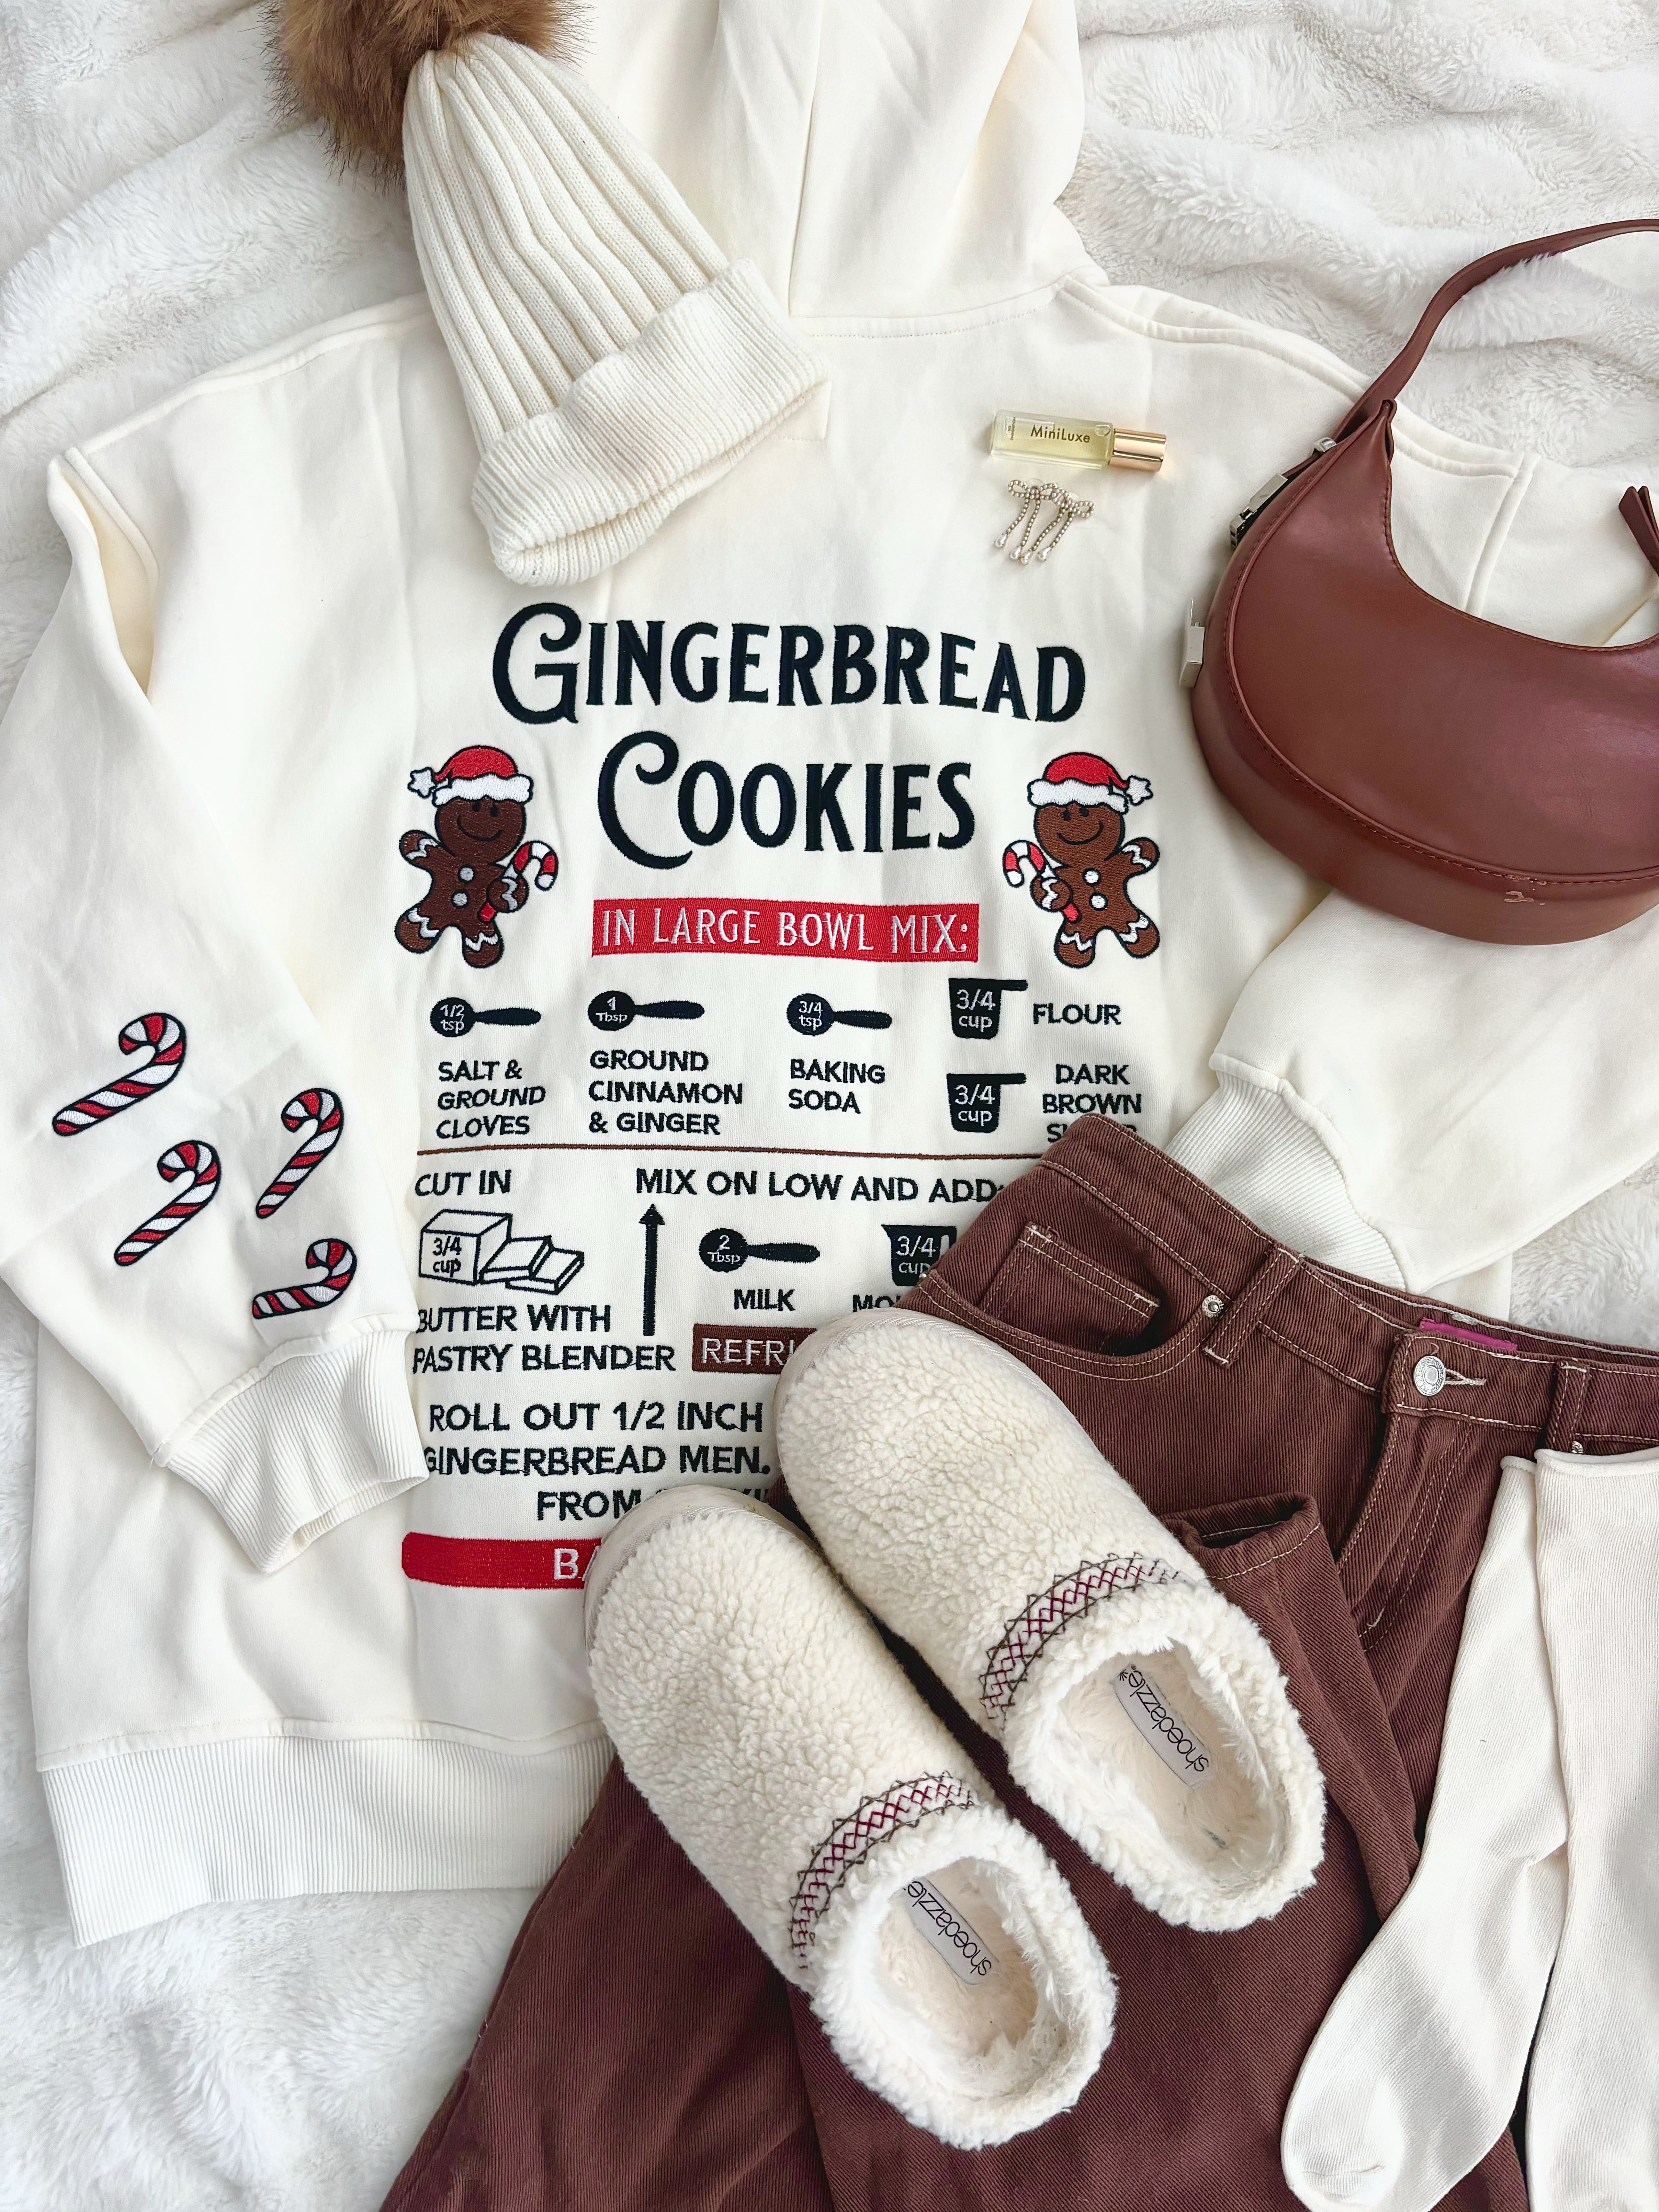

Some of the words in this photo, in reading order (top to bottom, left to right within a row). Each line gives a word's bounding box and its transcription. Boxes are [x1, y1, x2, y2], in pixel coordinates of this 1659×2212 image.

[1031, 425, 1090, 443] MiniLuxe
[493, 603, 1085, 724] GINGERBREAD
[598, 731, 975, 870] COOKIES
[602, 909, 635, 946] IN
[652, 907, 760, 945] LARGE
[778, 912, 873, 950] BOWL
[891, 914, 967, 953] MIX:
[607, 997, 616, 1010] 1
[799, 1001, 821, 1015] 3/4
[957, 989, 996, 1010] 3/4
[440, 1005, 464, 1017] 1/2
[596, 1012, 627, 1023] Tbsp
[799, 1014, 822, 1030] tsp
[1033, 1003, 1121, 1025] FLOUR
[440, 1018, 464, 1034] tsp
[959, 1016, 992, 1032] cup
[438, 1060, 500, 1082] SALT
[505, 1060, 522, 1079] &
[590, 1049, 709, 1071] GROUND
[790, 1059, 885, 1084] BAKING
[1056, 1064, 1130, 1085] DARK
[438, 1086, 546, 1110] GROUND
[589, 1080, 742, 1104] CINNAMON
[788, 1089, 860, 1114] SODA
[955, 1084, 995, 1105] 3/4
[1042, 1093, 1142, 1113] BROWN
[436, 1115, 530, 1139] CLOVES
[589, 1111, 608, 1133] &
[617, 1112, 720, 1135] GINGER
[958, 1111, 992, 1126] cup
[415, 1171, 471, 1196] CUT
[479, 1170, 512, 1195] IN
[637, 1168, 697, 1195] MIX
[707, 1171, 757, 1195] ON
[769, 1172, 843, 1200] LOW
[851, 1176, 918, 1201] AND
[433, 1236, 462, 1256] 3/4
[719, 1235, 730, 1250] 2
[896, 1236, 936, 1257] 3/4
[433, 1259, 462, 1278] cup
[708, 1252, 740, 1264] Tbsp
[734, 1289, 795, 1311] MILK
[416, 1305, 517, 1334] BUTTER
[527, 1304, 611, 1332] WITH
[412, 1344, 513, 1374] PASTRY
[522, 1345, 676, 1371] BLENDER
[430, 1403, 510, 1432] ROLL
[524, 1403, 600, 1431] OUT
[613, 1400, 665, 1431] 1/2
[678, 1401, 763, 1432] INCH
[424, 1445, 666, 1477] GINGERBREAD
[680, 1445, 771, 1475] MEN.
[538, 1489, 641, 1521] FROM
[1128, 1670, 1209, 1772] shoedazzle
[908, 1881, 991, 1976] shoedazzle
